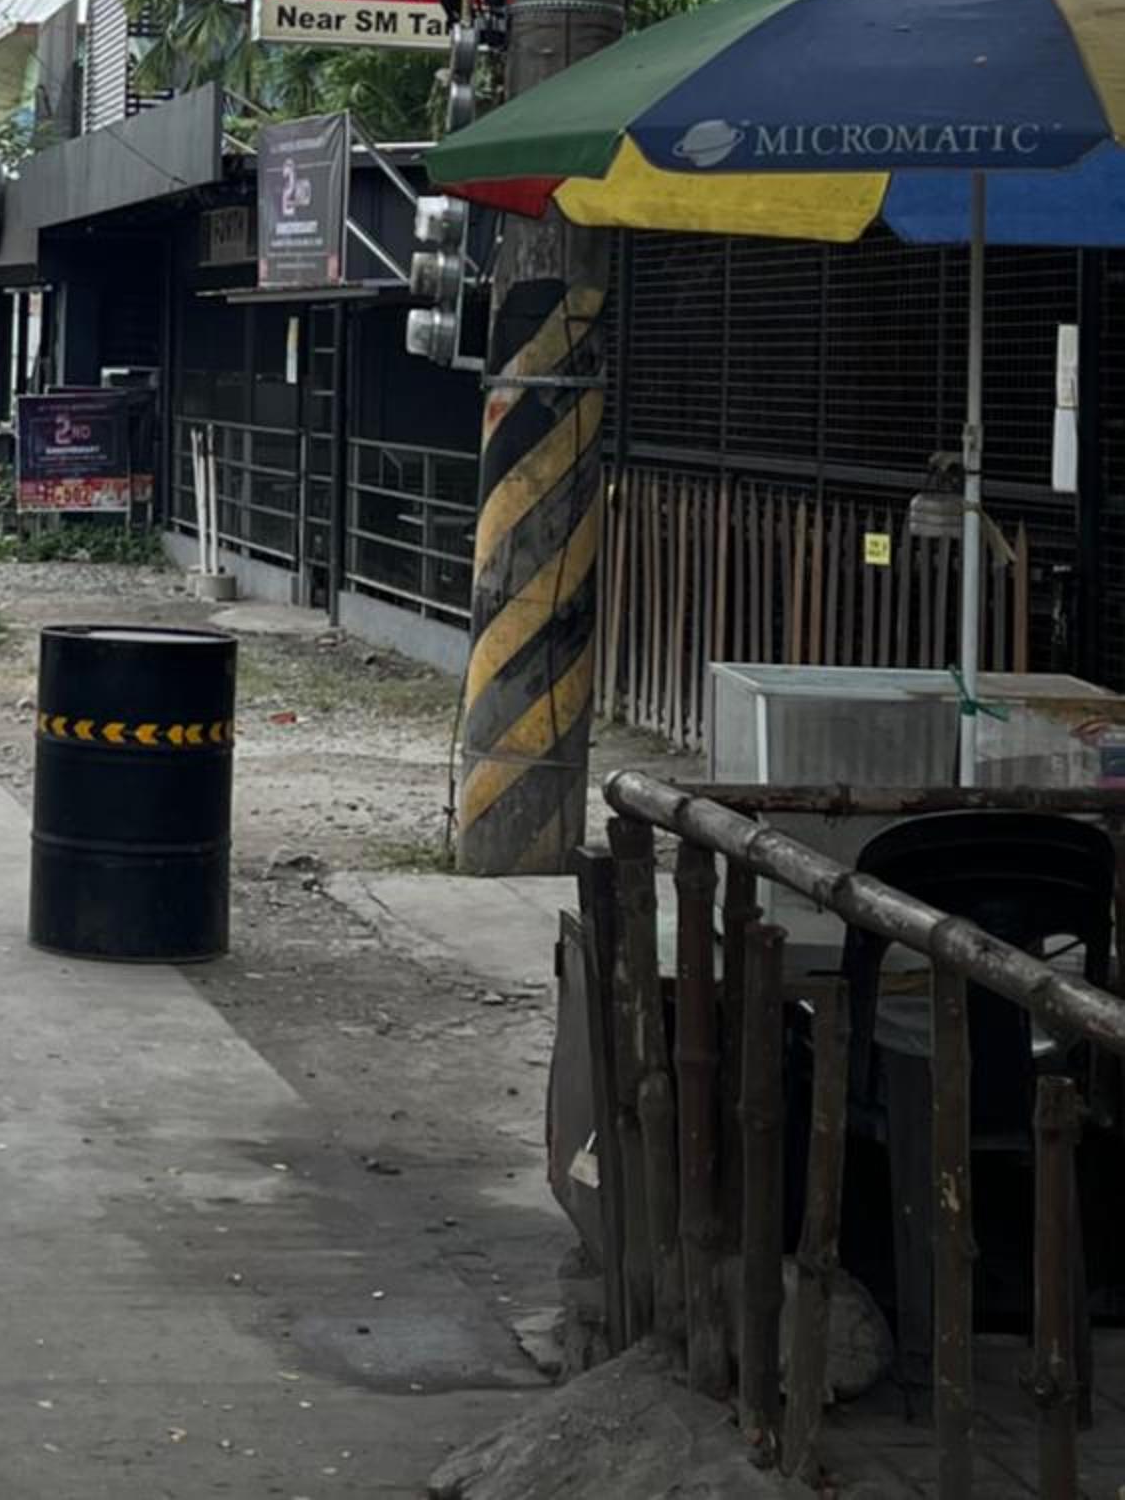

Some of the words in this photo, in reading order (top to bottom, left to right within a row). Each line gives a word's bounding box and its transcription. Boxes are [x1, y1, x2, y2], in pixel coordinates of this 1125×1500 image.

[277, 5, 346, 32] Near
[355, 10, 398, 33] SM
[408, 13, 451, 36] Tar
[754, 124, 1040, 155] MICROMATIC
